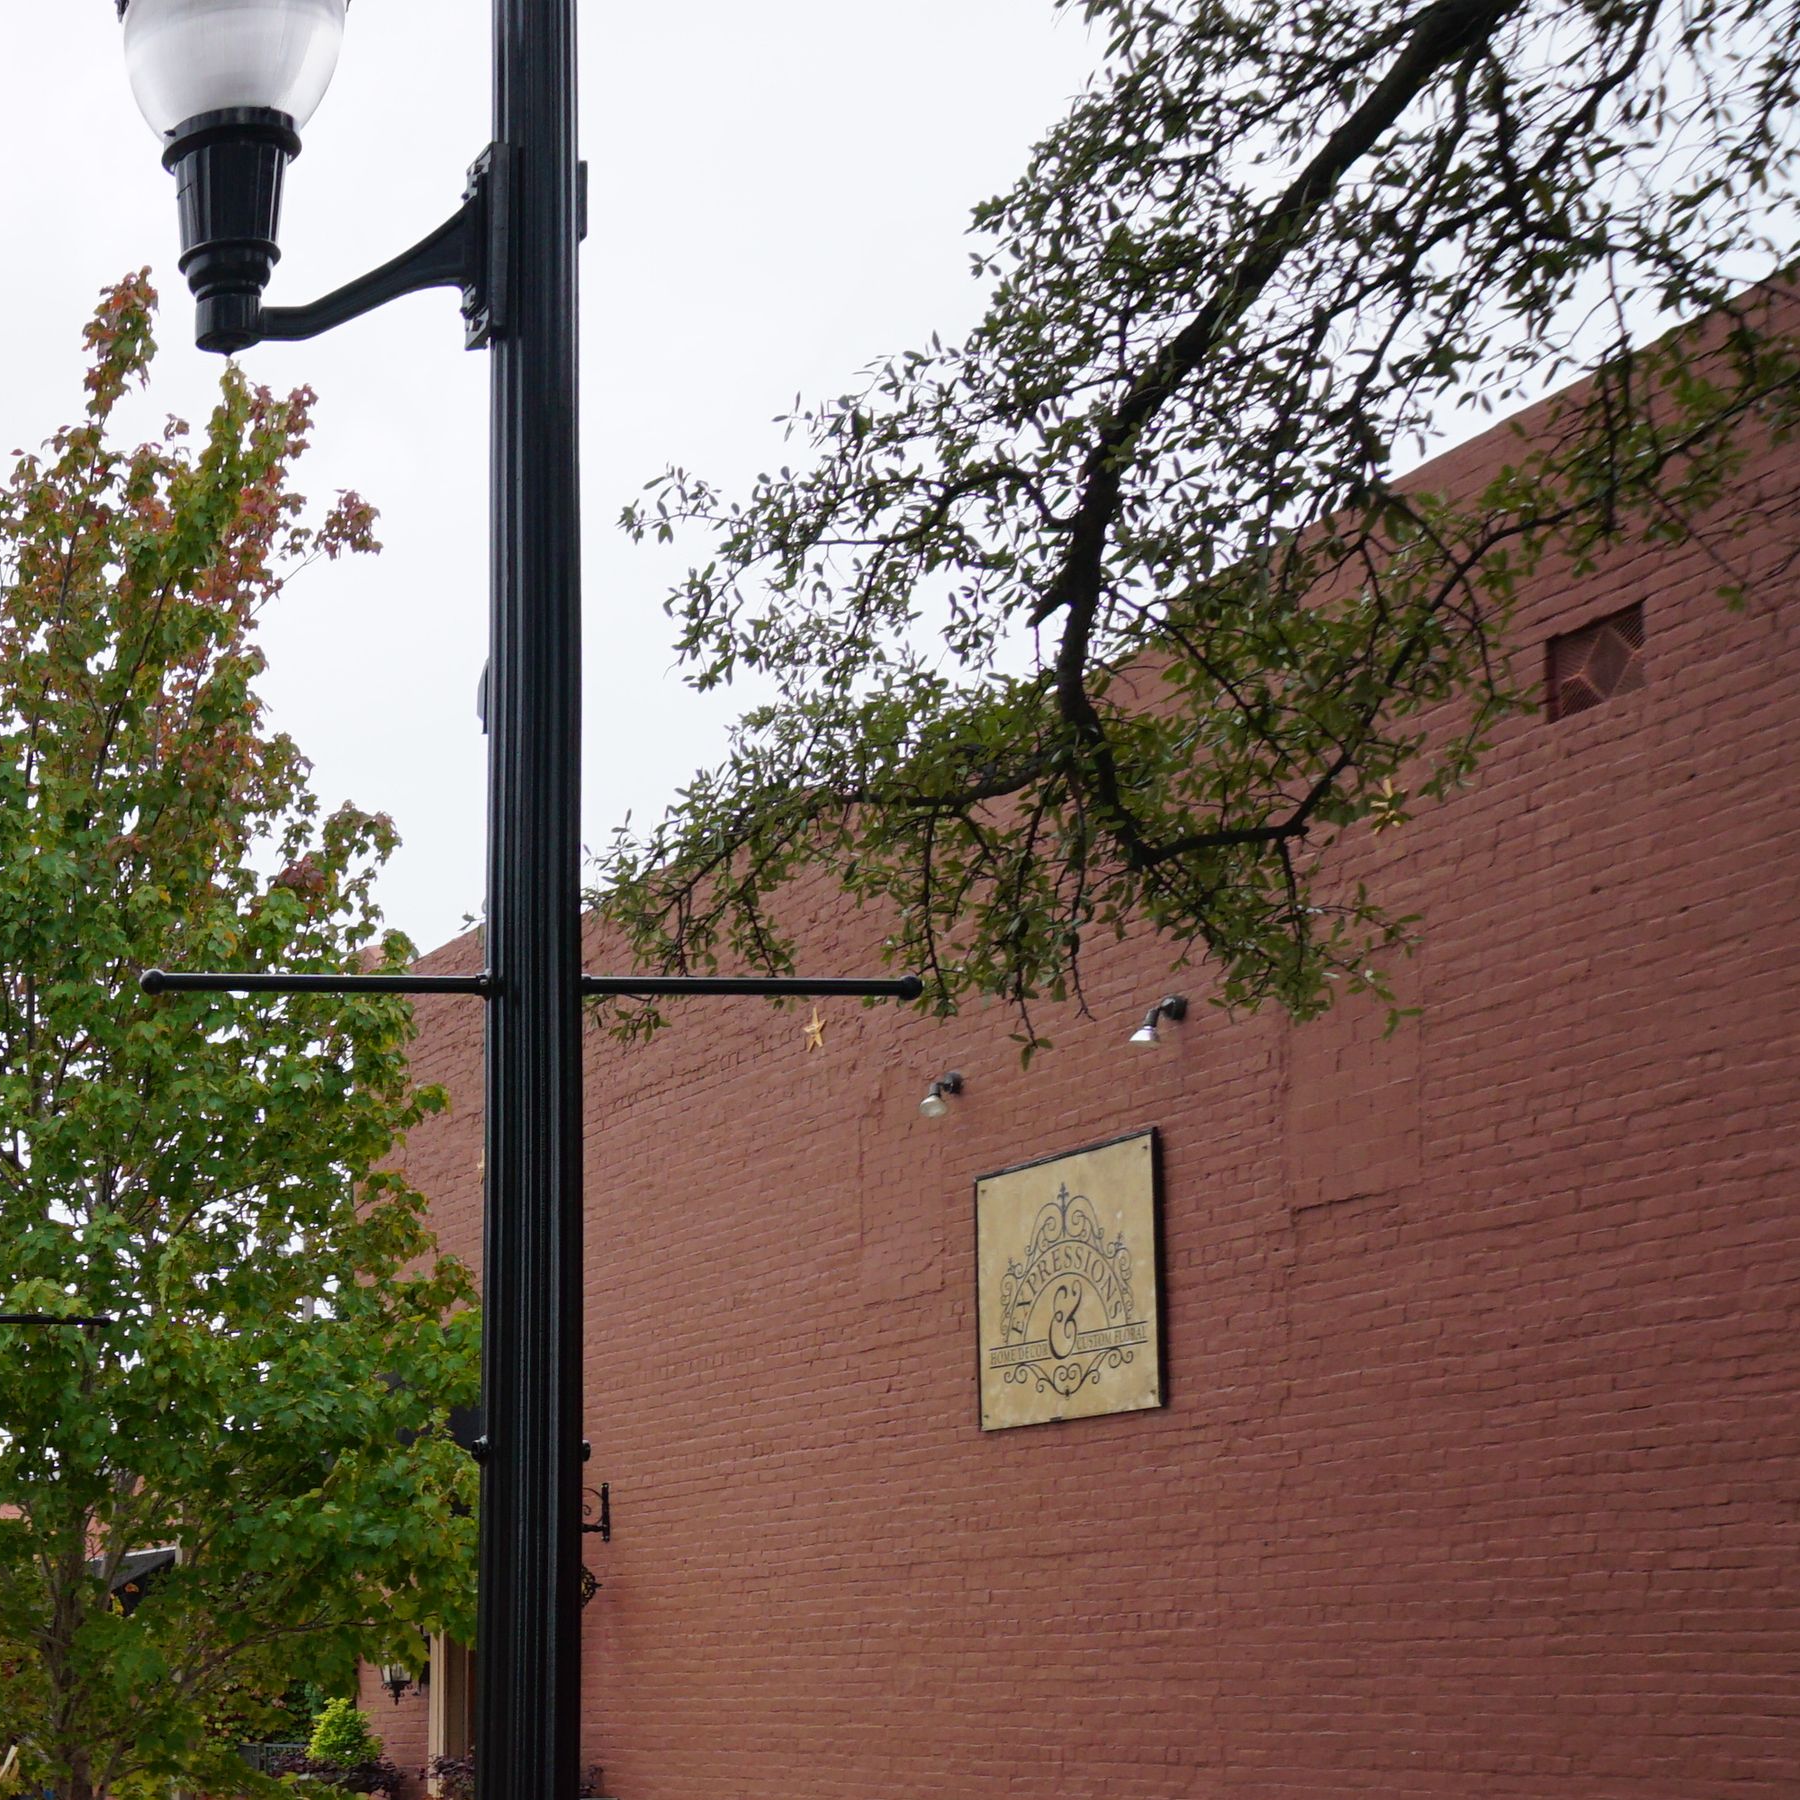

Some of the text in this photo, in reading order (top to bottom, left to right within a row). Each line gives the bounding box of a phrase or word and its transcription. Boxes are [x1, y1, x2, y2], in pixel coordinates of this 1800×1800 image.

[1011, 1245, 1123, 1335] EXPRESSIONS
[990, 1348, 1019, 1366] HOME
[1018, 1343, 1049, 1361] DECOR
[1076, 1331, 1113, 1351] CUSTOM
[1114, 1324, 1148, 1345] FLORAL
